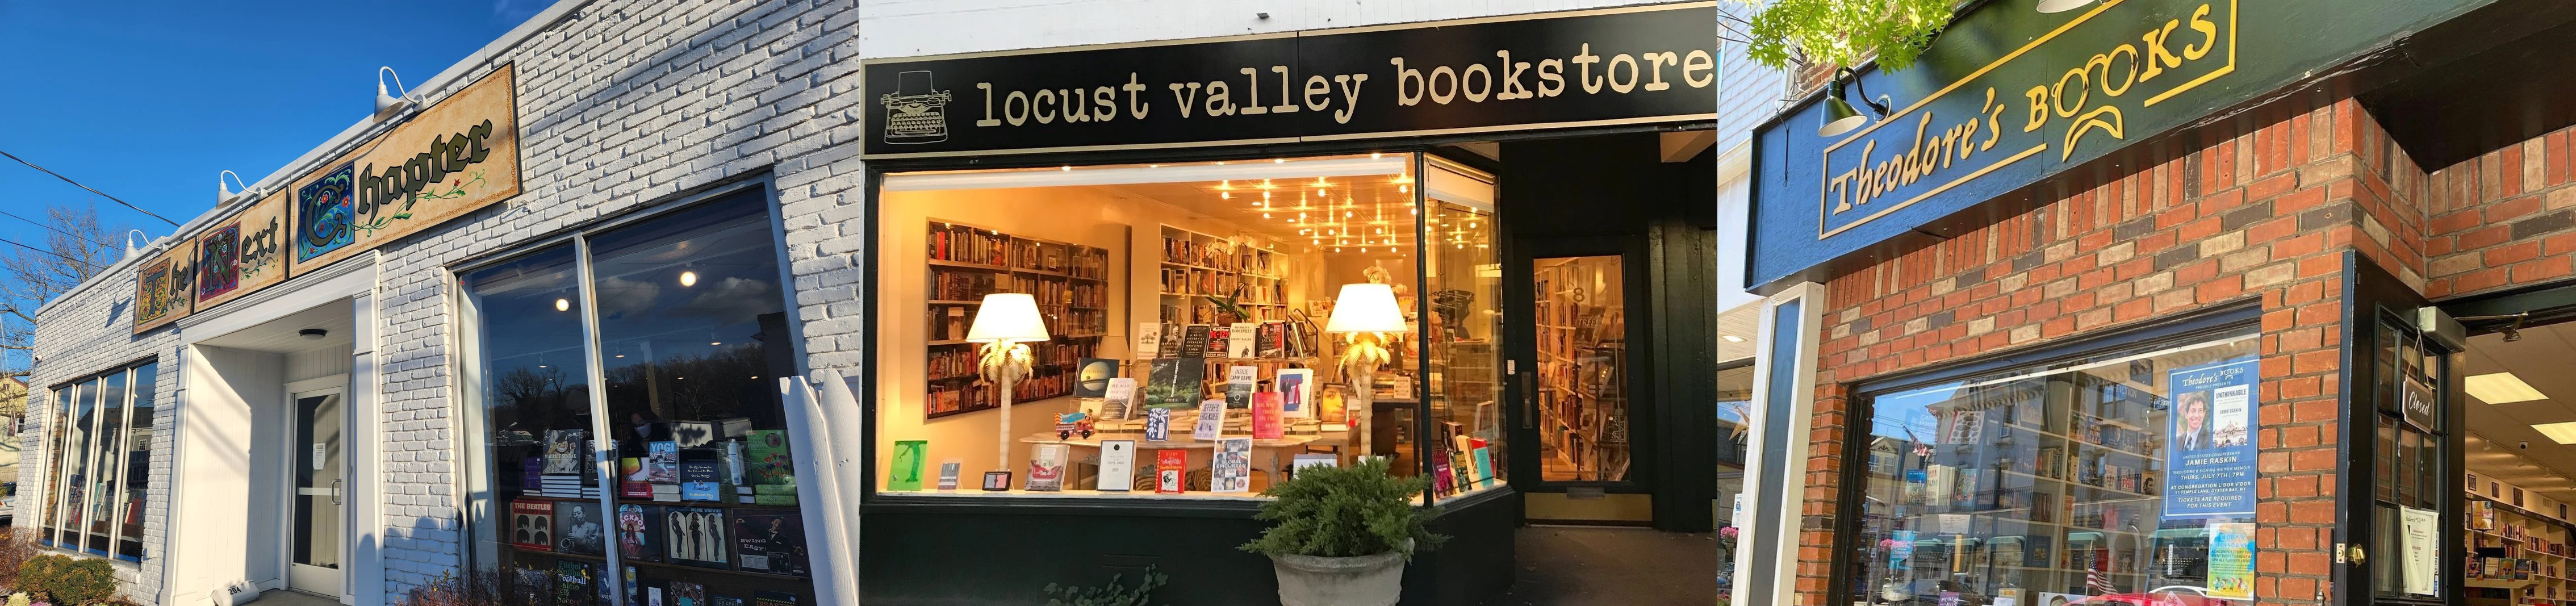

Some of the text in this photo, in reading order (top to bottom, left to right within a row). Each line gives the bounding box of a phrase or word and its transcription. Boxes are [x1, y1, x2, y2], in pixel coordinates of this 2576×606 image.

[976, 43, 1713, 127] locust valley bookstore
[1830, 3, 2217, 217] Theodore's BOOKS
[144, 119, 492, 316] The Next Chapter
[1573, 287, 1585, 303] 8
[2182, 367, 2244, 387] Theodore's BOOKS
[2216, 388, 2247, 399] UNTHINKABLE
[2408, 391, 2430, 416] Closed
[650, 442, 674, 452] YOGI
[2210, 456, 2237, 465] RASKIN
[1906, 480, 1925, 489] family
[228, 586, 241, 595] 204
